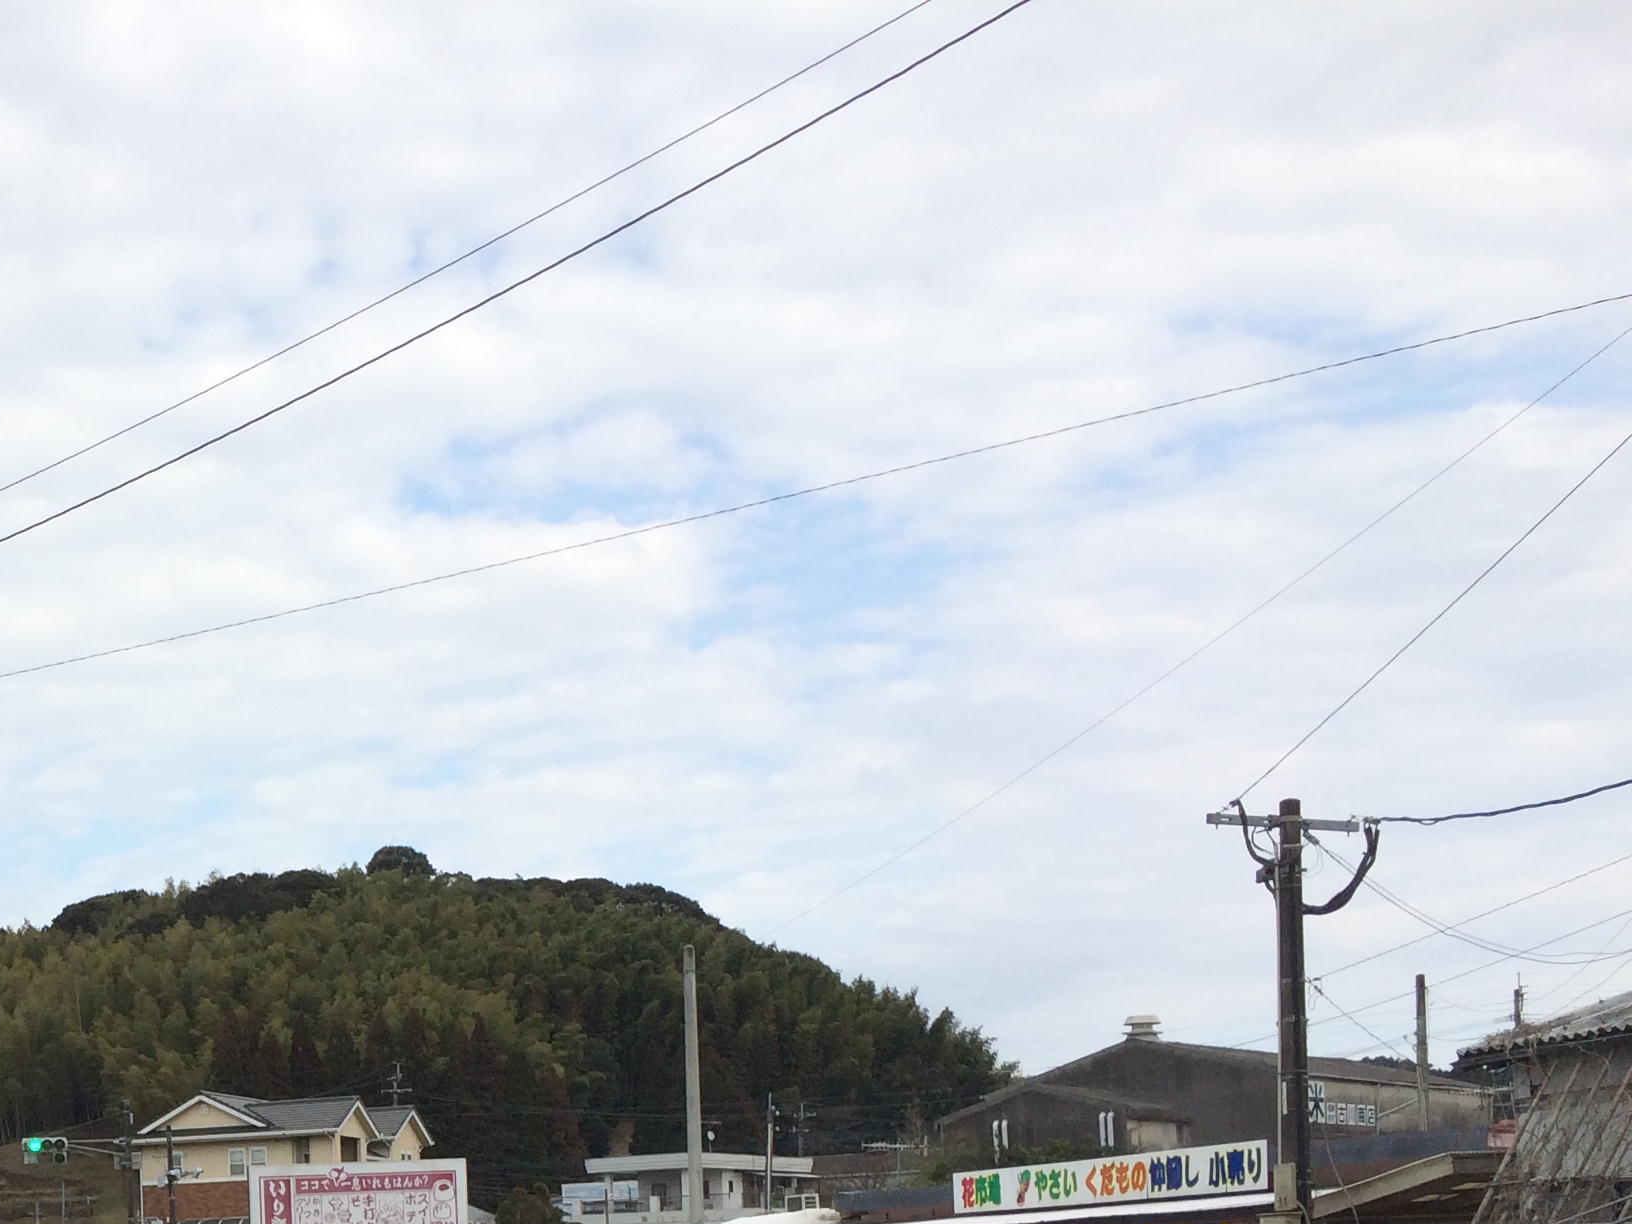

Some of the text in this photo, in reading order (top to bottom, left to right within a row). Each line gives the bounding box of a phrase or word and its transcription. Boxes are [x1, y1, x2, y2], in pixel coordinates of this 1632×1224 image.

[300, 1179, 330, 1191] ココで
[1034, 1168, 1077, 1202] やさい
[1085, 1160, 1147, 1199] くだもの
[1208, 1147, 1262, 1188] 小売り
